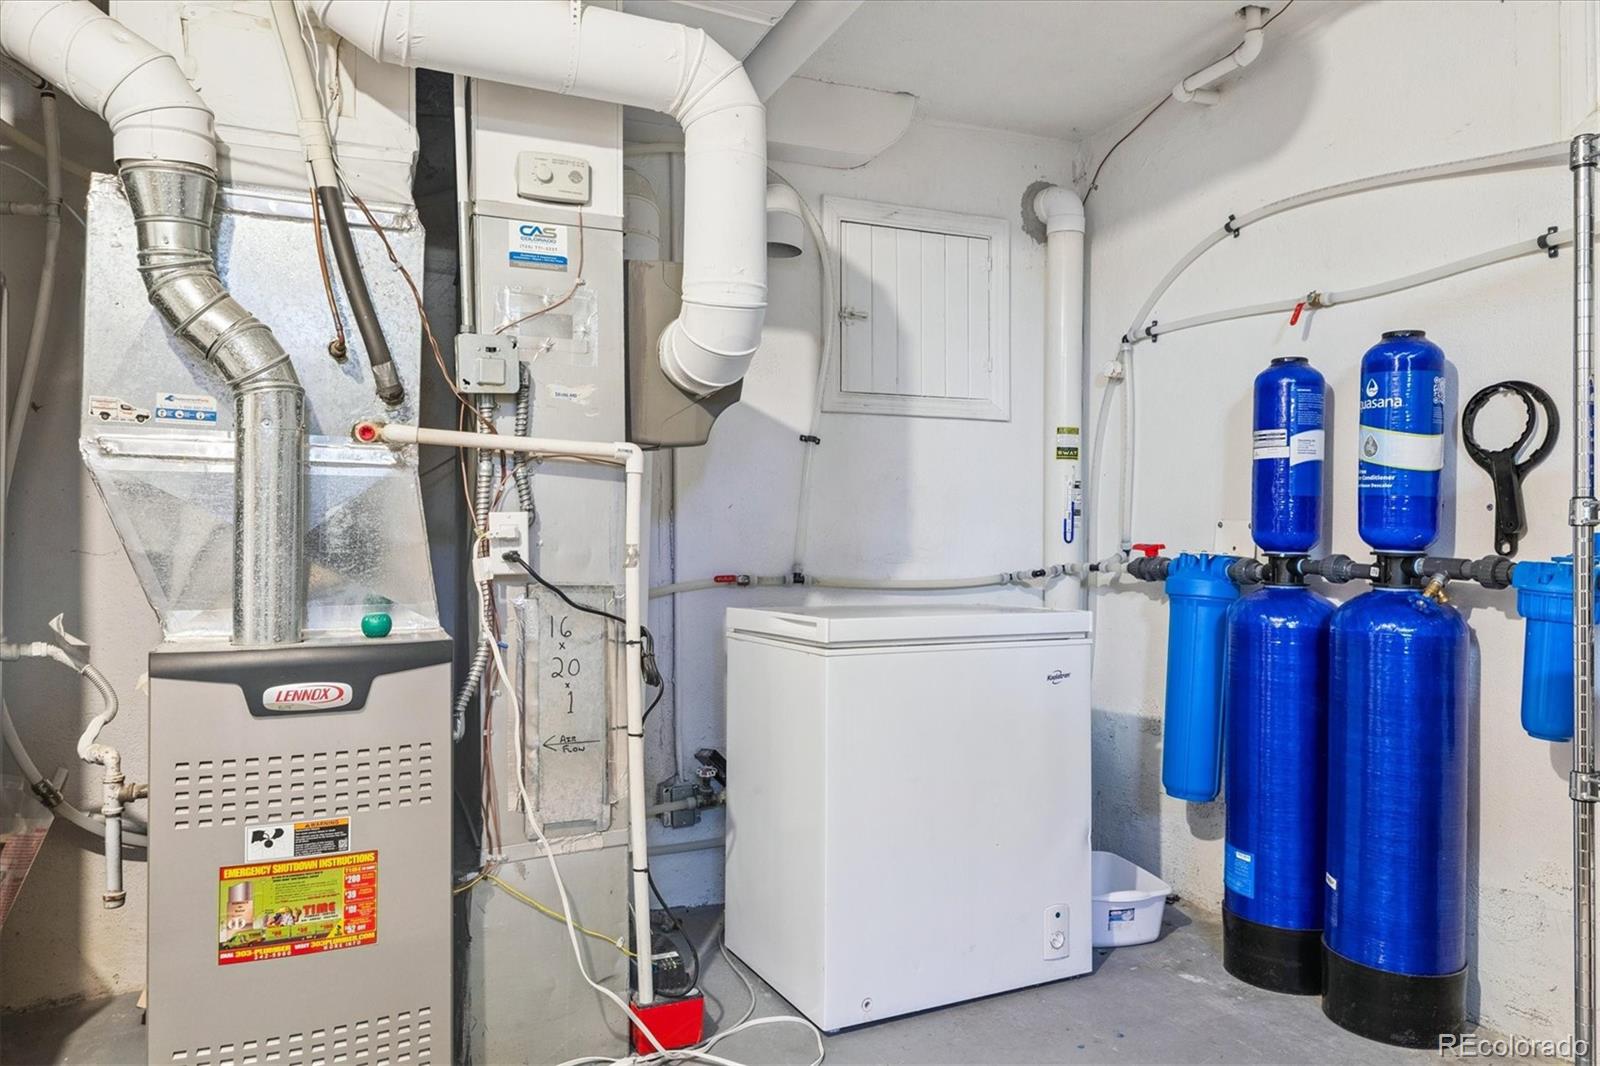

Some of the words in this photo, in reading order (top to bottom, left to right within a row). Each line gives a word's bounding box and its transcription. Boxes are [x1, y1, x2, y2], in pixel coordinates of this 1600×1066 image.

[519, 225, 557, 238] CAS
[550, 615, 572, 638] 16
[551, 656, 581, 678] 20
[275, 688, 331, 703] LENNOX
[567, 690, 574, 714] 1
[562, 744, 586, 753] FLOW
[311, 819, 339, 828] WARNING
[224, 866, 271, 879] EMERGENCY
[272, 861, 318, 874] SHUTDOWN
[319, 852, 375, 868] INSTRUCTIONS
